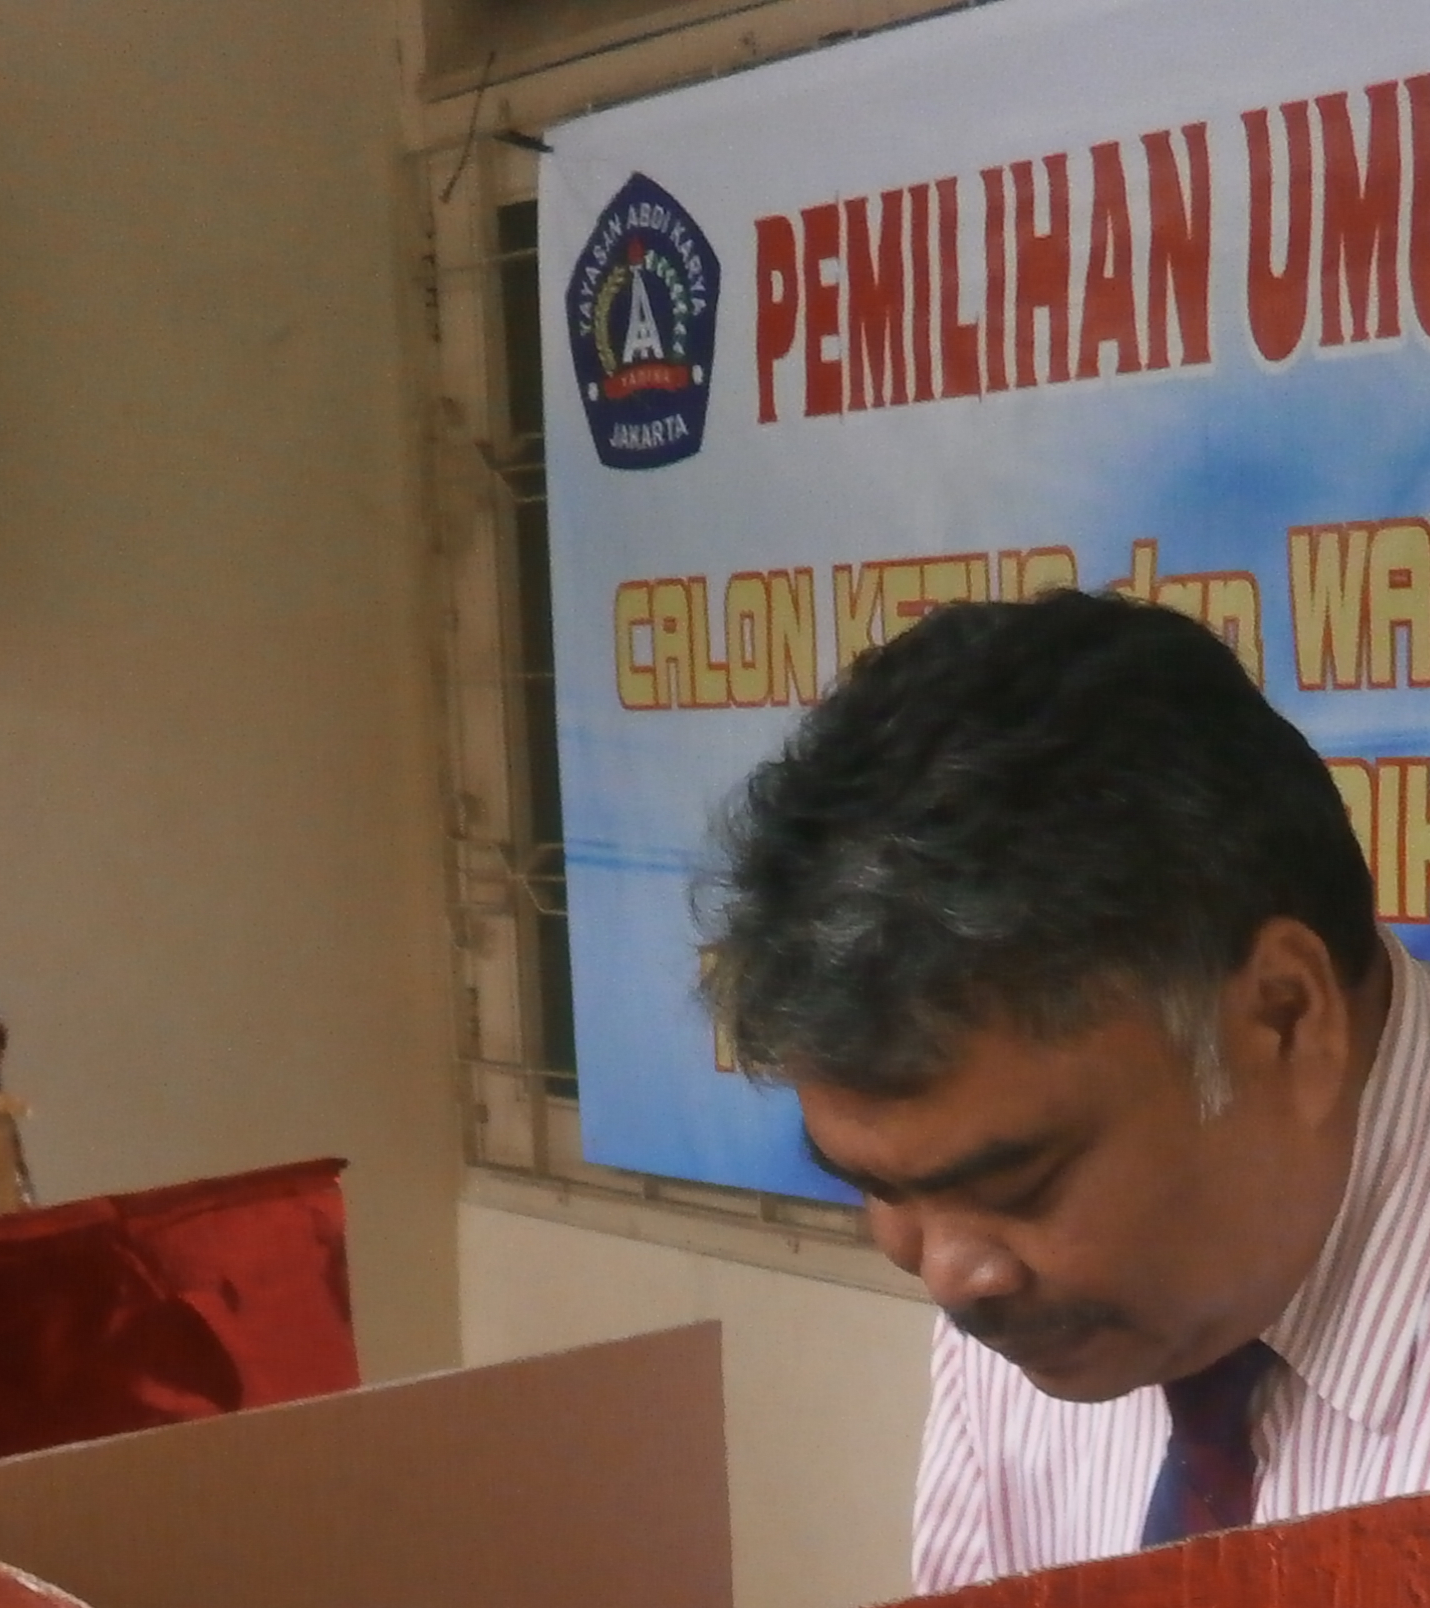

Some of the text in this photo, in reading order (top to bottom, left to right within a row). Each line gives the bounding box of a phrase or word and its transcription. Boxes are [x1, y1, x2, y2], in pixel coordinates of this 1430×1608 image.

[579, 202, 707, 337] YAYASAN ABDI KARYA
[754, 121, 1213, 425] PEMILIHAN
[609, 413, 690, 451] JAKARTA
[613, 566, 823, 711] CALON
